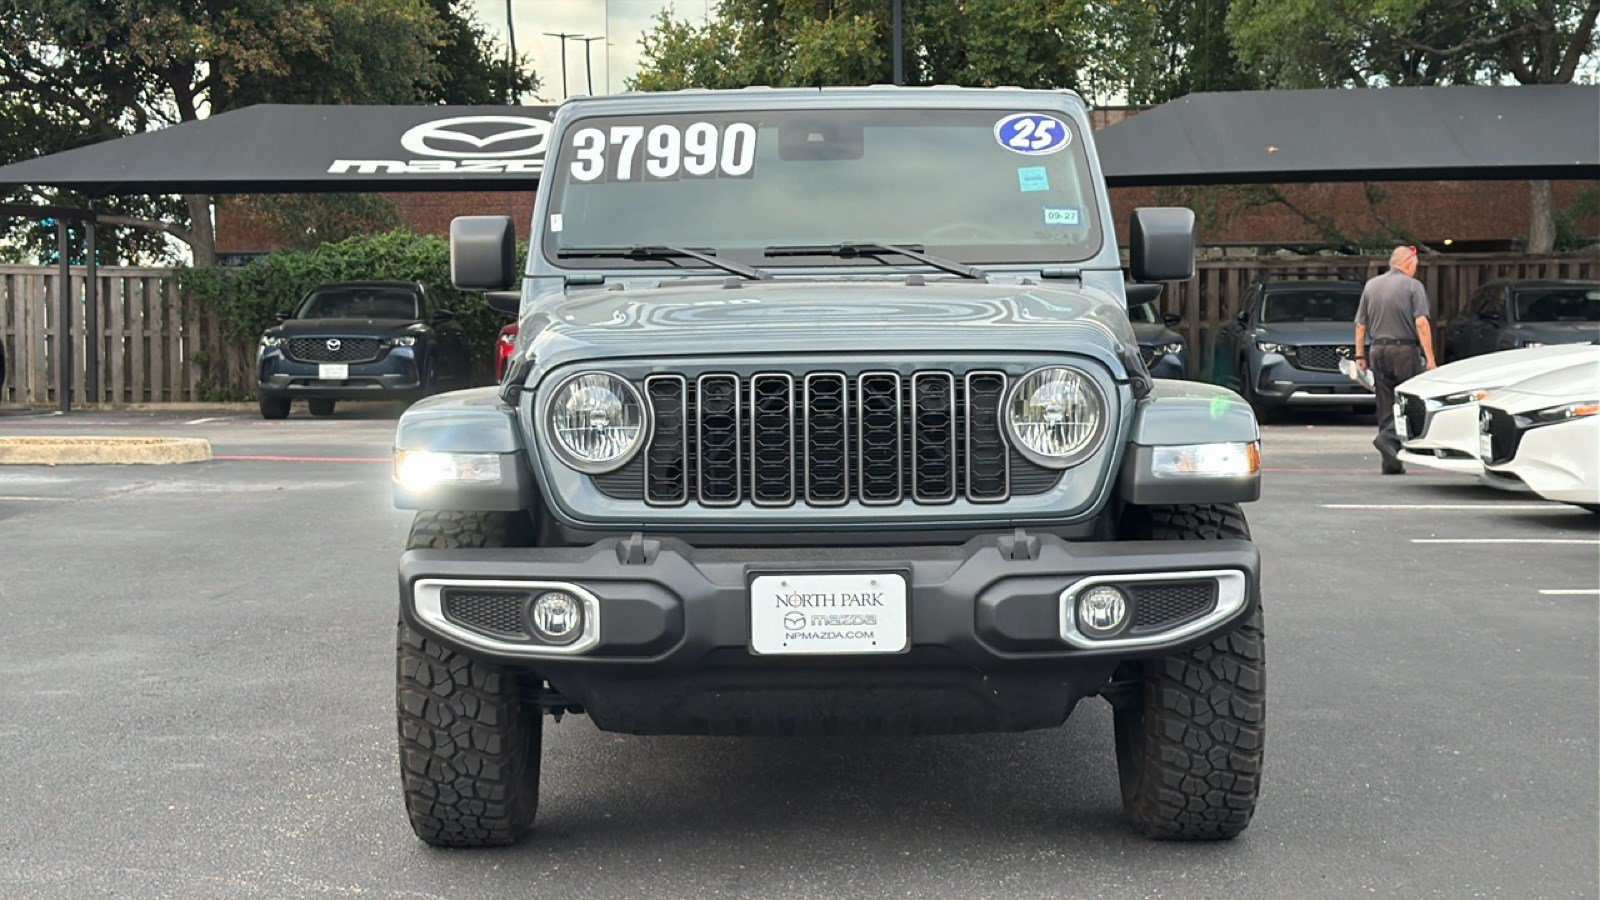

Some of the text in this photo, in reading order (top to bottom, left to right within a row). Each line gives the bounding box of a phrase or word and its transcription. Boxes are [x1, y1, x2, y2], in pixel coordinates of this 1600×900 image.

[1009, 118, 1056, 149] 25
[570, 122, 757, 181] 37990
[775, 592, 885, 608] NORTH PARK
[785, 630, 875, 640] NPMAZDA.COM
